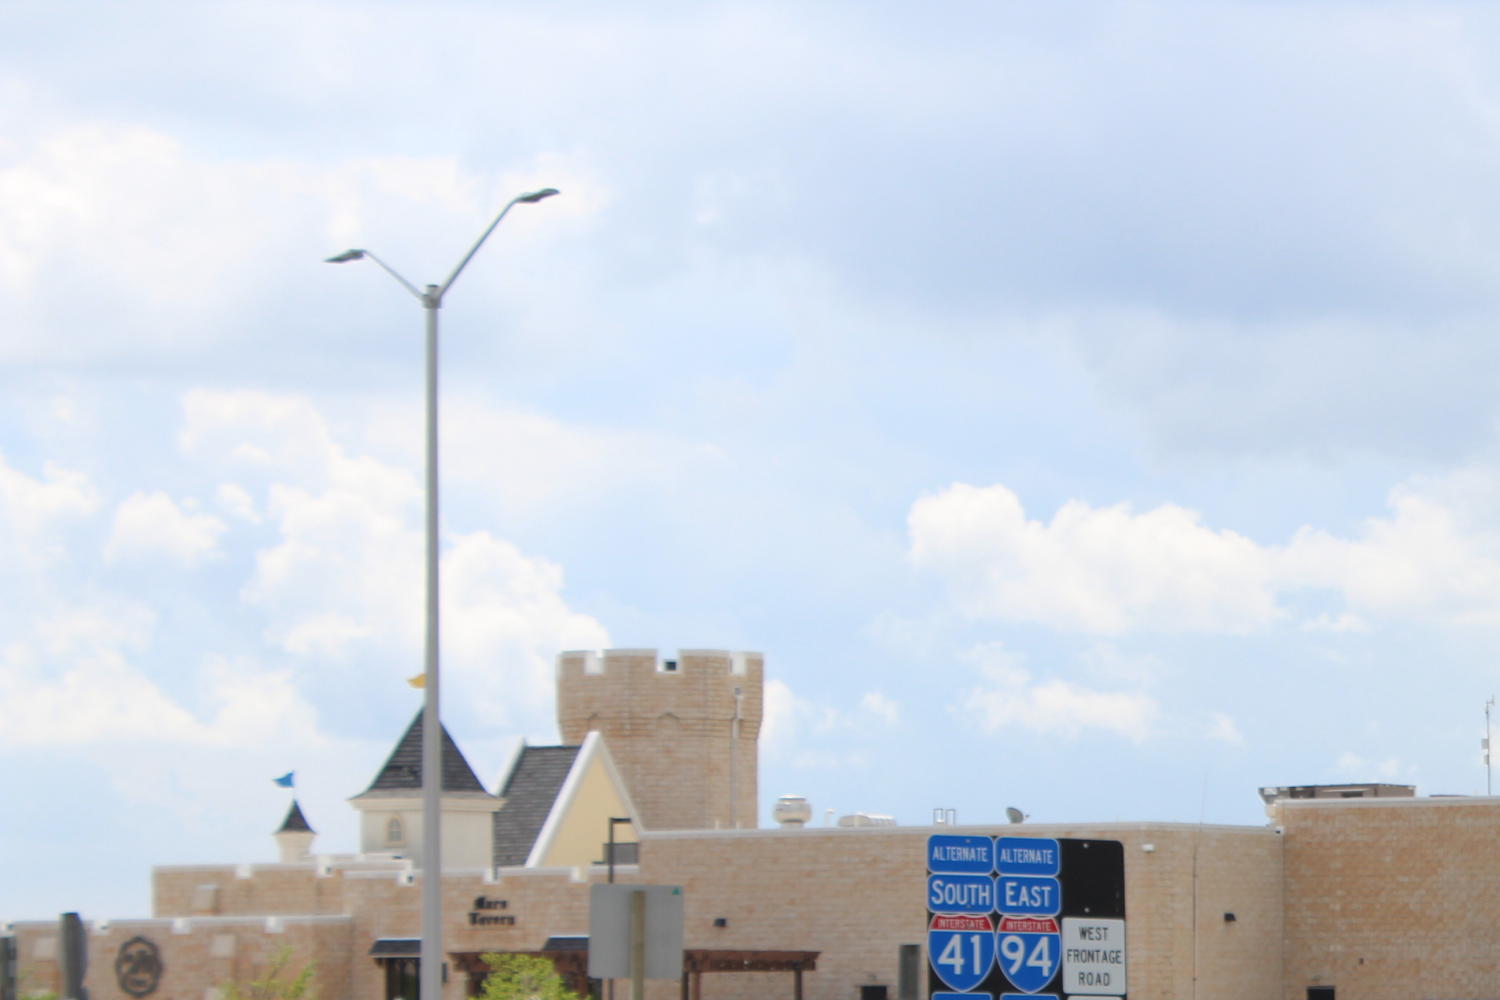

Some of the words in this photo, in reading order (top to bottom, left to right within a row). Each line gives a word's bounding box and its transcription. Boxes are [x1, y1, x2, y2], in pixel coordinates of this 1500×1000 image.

[932, 846, 988, 862] ALTERNATE
[1000, 848, 1054, 864] ALTERNATE
[931, 880, 990, 905] SOUTH
[1005, 882, 1051, 907] EAST
[938, 918, 984, 930] INTERSTATE
[1006, 920, 1051, 931] INTERSTATE
[1079, 927, 1108, 941] WEST
[937, 934, 981, 975] 41
[1001, 936, 1052, 977] 94
[1067, 950, 1122, 964] FRONTAGE
[1079, 972, 1110, 986] ROAD
